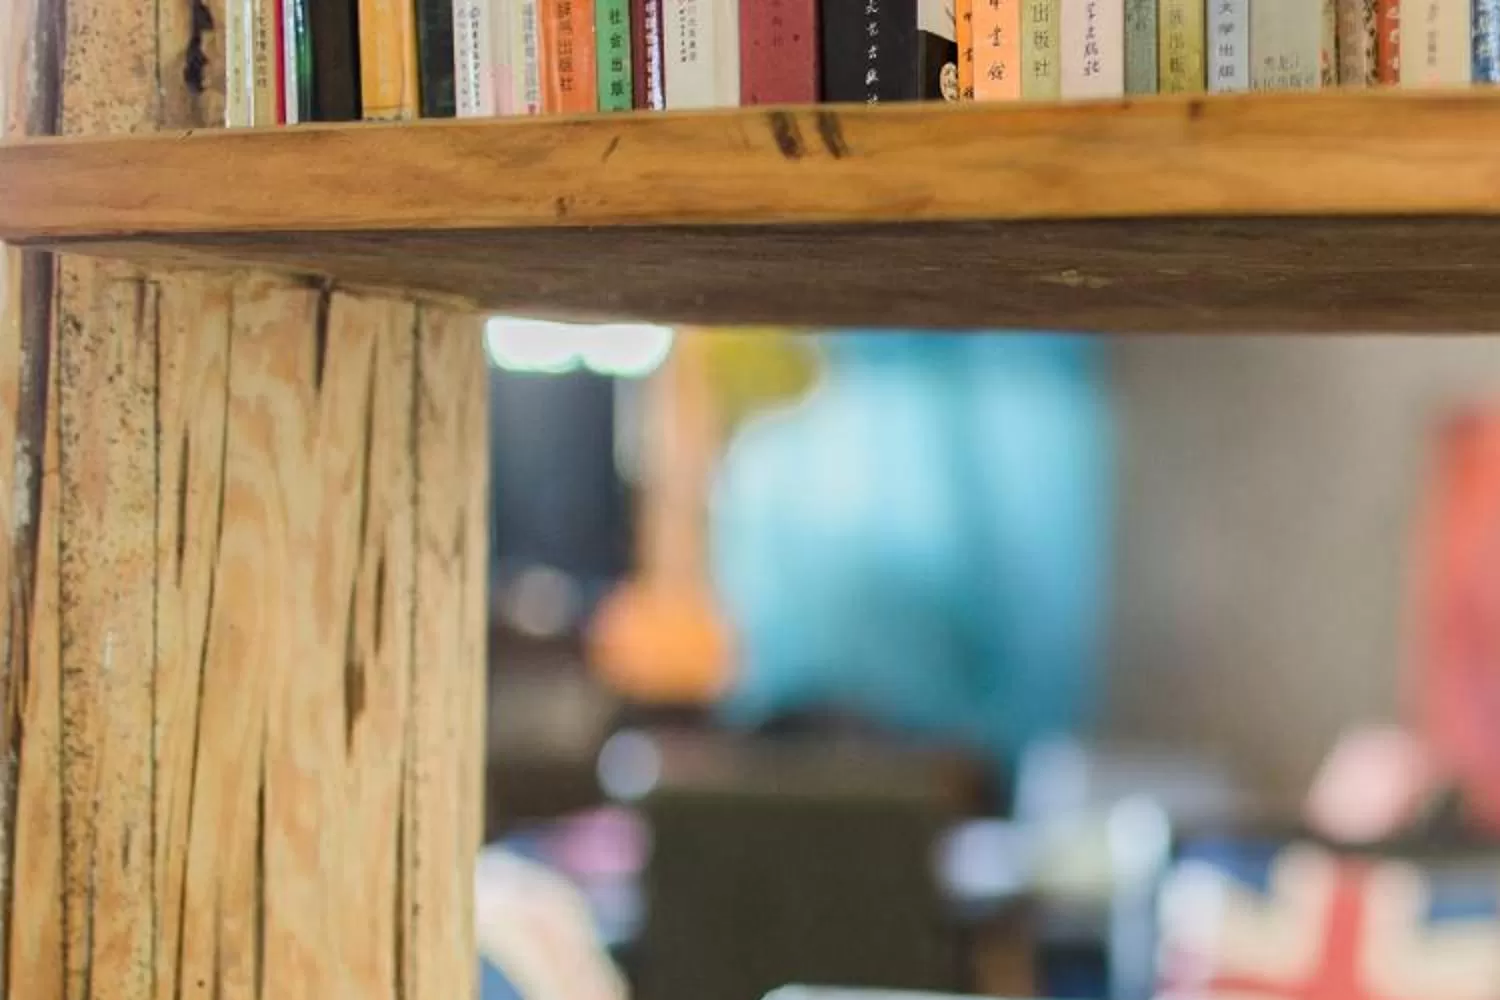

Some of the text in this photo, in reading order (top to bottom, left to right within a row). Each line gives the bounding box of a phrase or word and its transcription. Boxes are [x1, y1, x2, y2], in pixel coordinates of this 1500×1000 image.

[608, 7, 625, 111] 社会出版
[1031, 3, 1051, 77] 出版社
